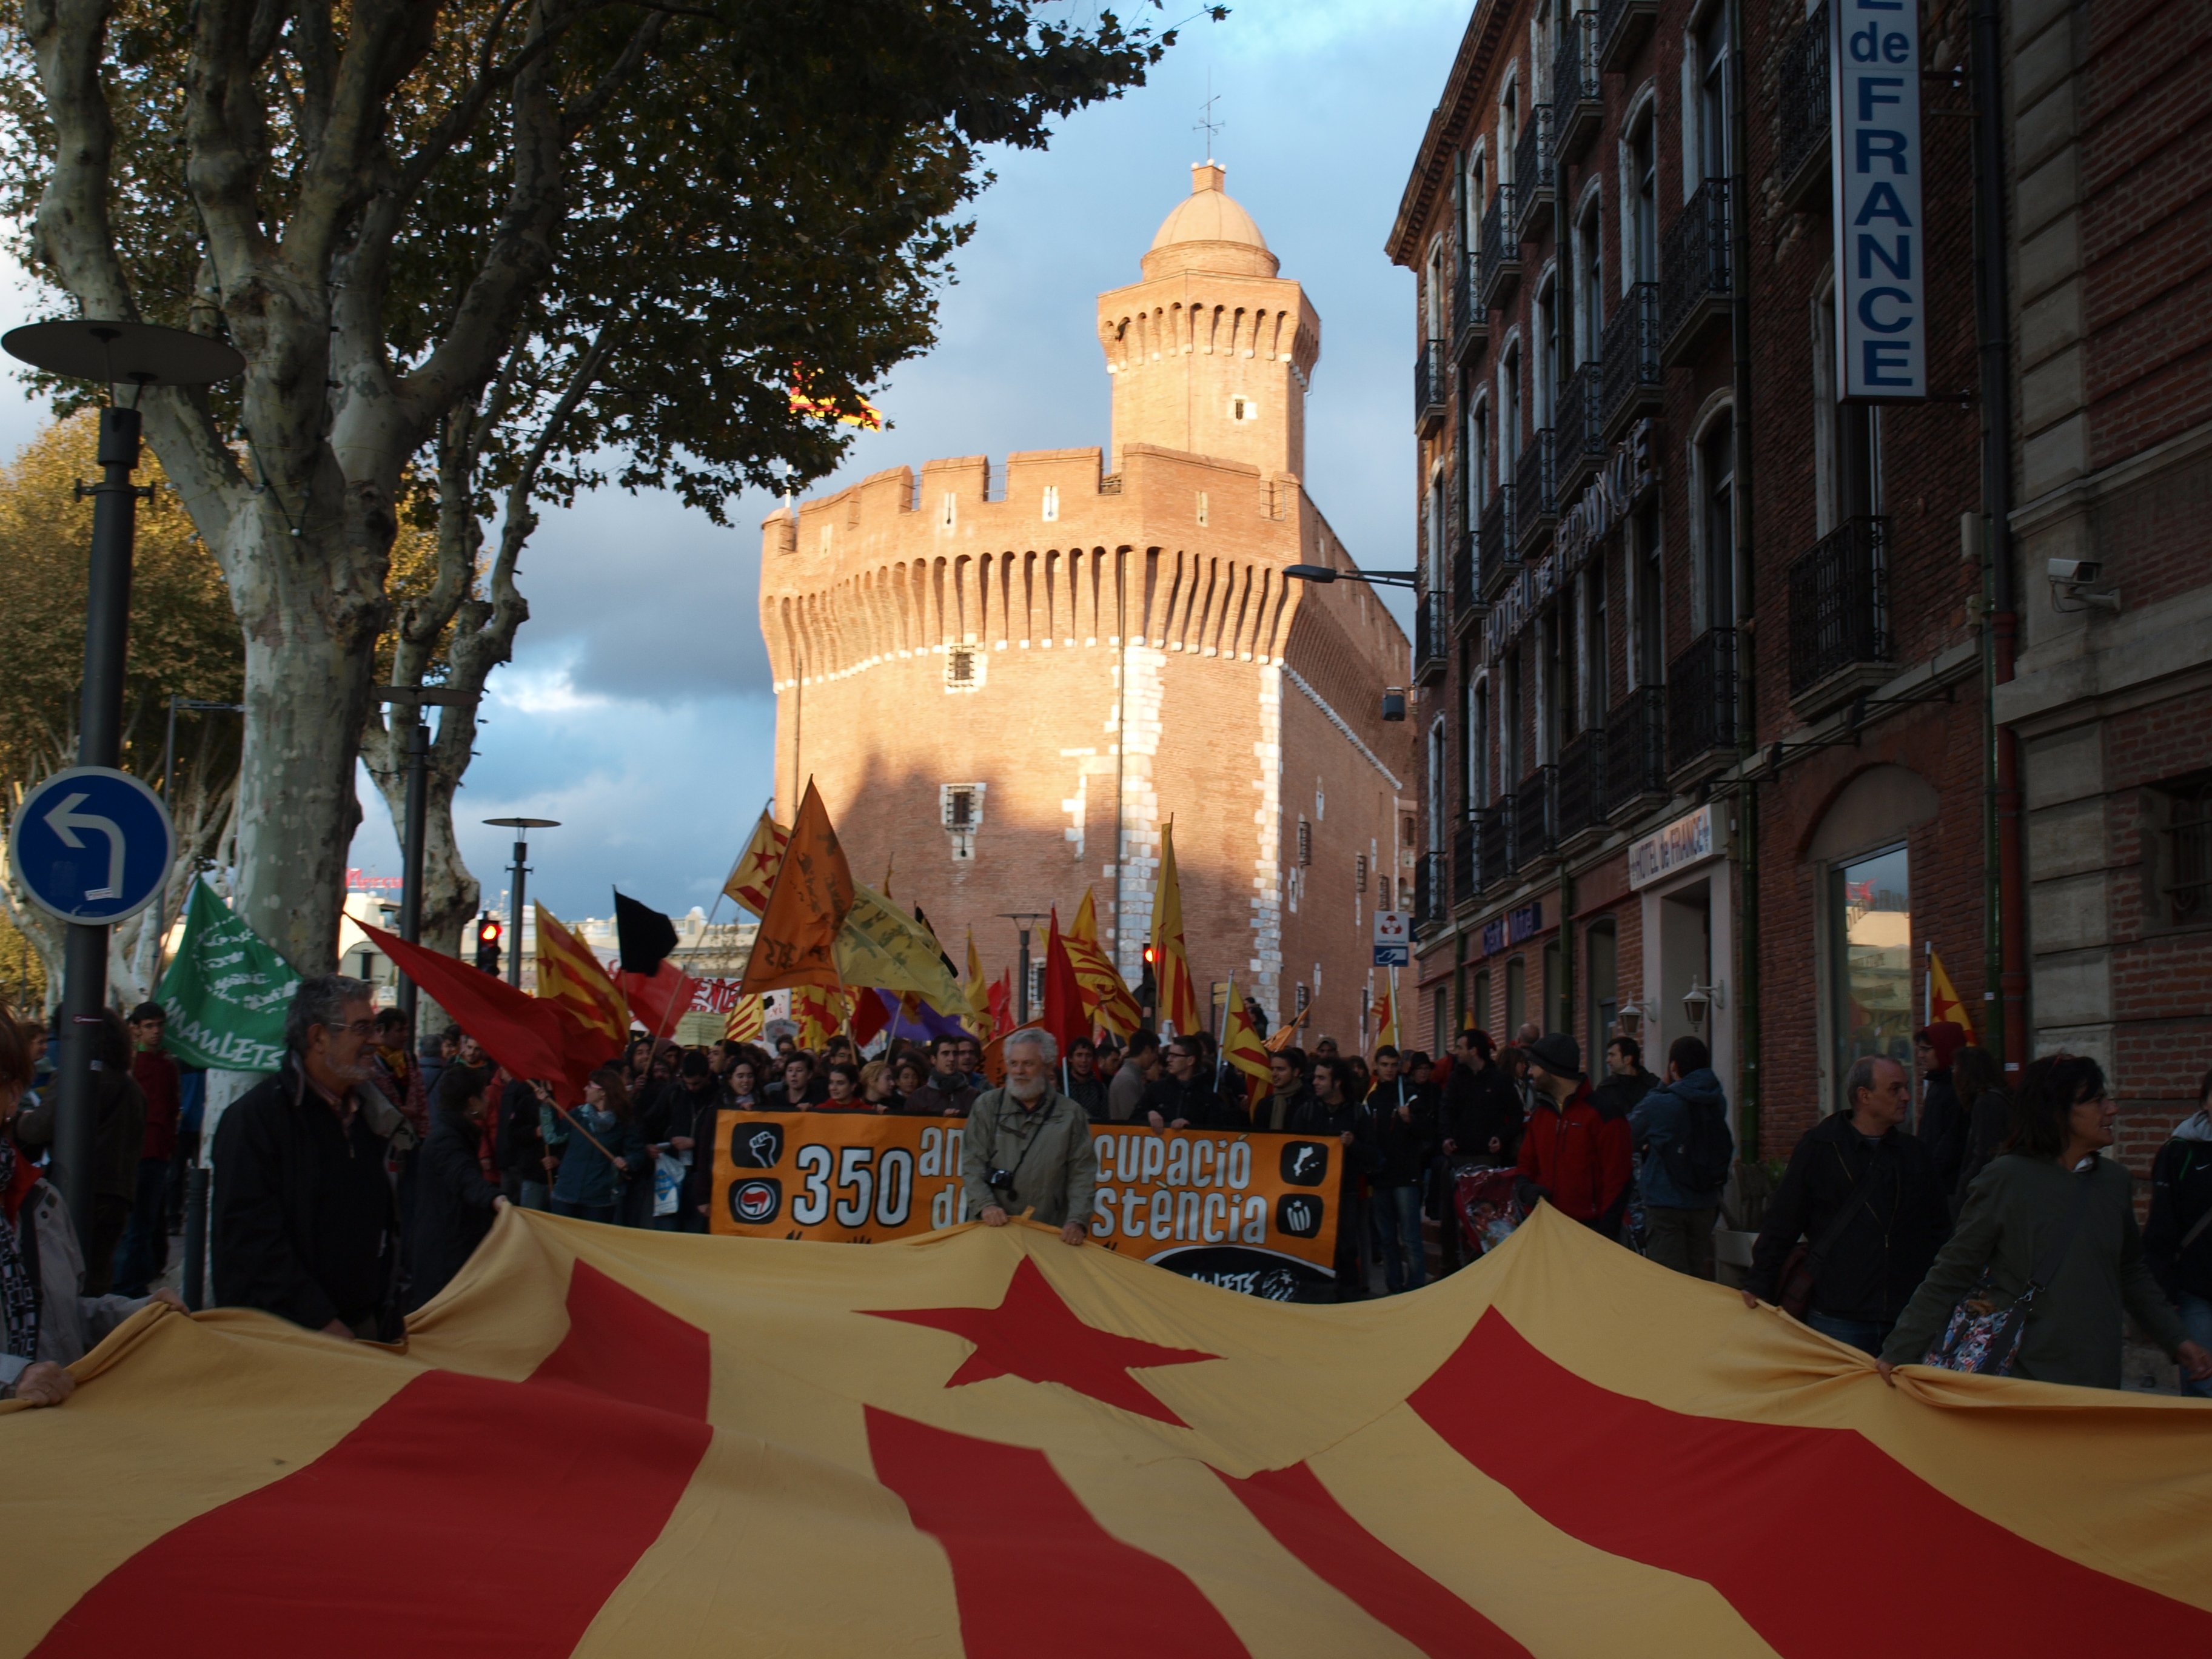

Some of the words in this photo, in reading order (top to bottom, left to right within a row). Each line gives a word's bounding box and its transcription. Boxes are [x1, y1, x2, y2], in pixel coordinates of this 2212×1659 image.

[1850, 21, 1909, 64] de
[1853, 76, 1913, 387] FRANCE
[346, 868, 404, 888] Mercu
[166, 997, 287, 1068] MAULETS
[793, 1144, 914, 1227] 350
[919, 1126, 965, 1177] an
[1093, 1133, 1252, 1190] cupació
[1091, 1181, 1269, 1245] stència
